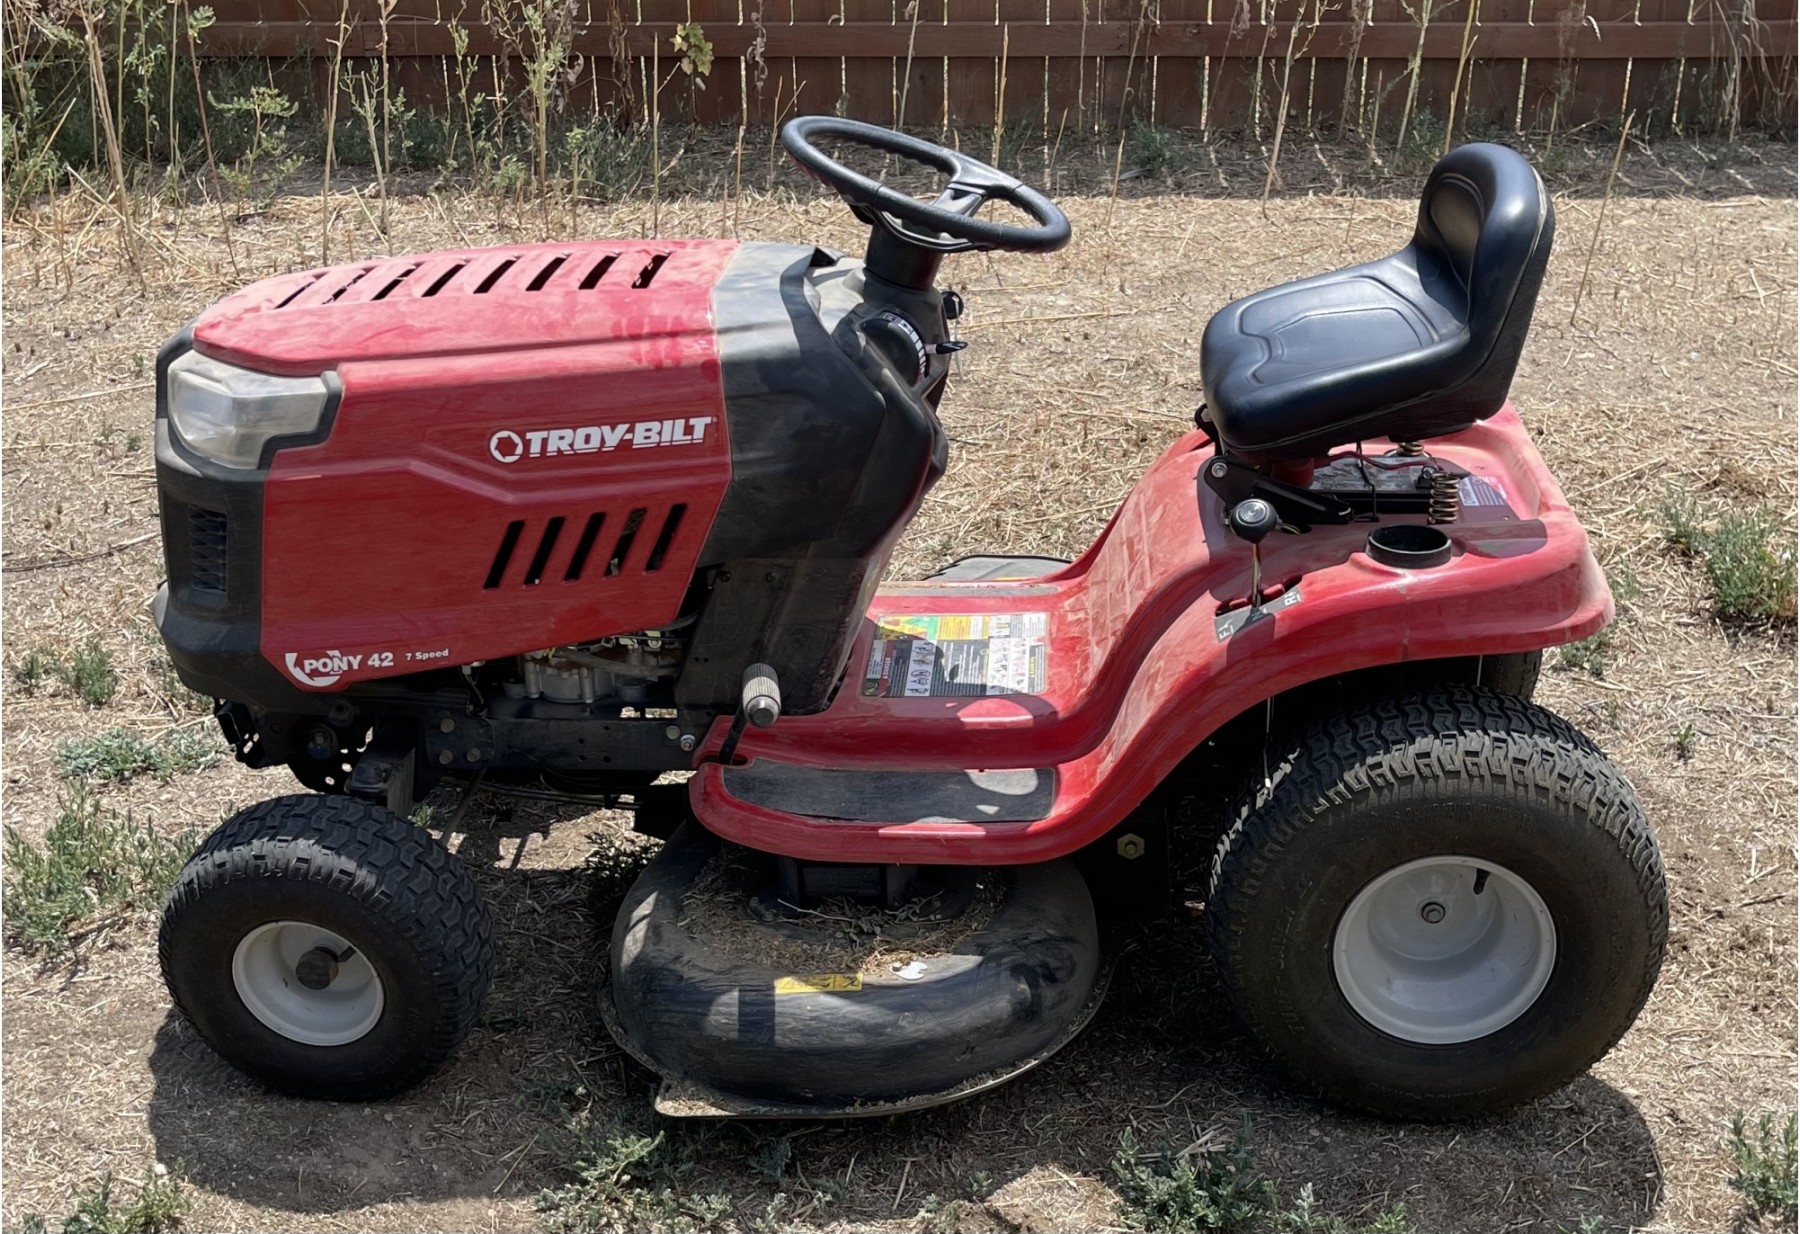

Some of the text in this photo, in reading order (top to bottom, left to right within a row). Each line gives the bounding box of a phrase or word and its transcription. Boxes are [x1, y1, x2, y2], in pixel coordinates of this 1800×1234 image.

[525, 416, 712, 457] TROY-BILT
[303, 654, 363, 674] PONY
[367, 652, 394, 668] 42
[415, 649, 449, 661] Speed
